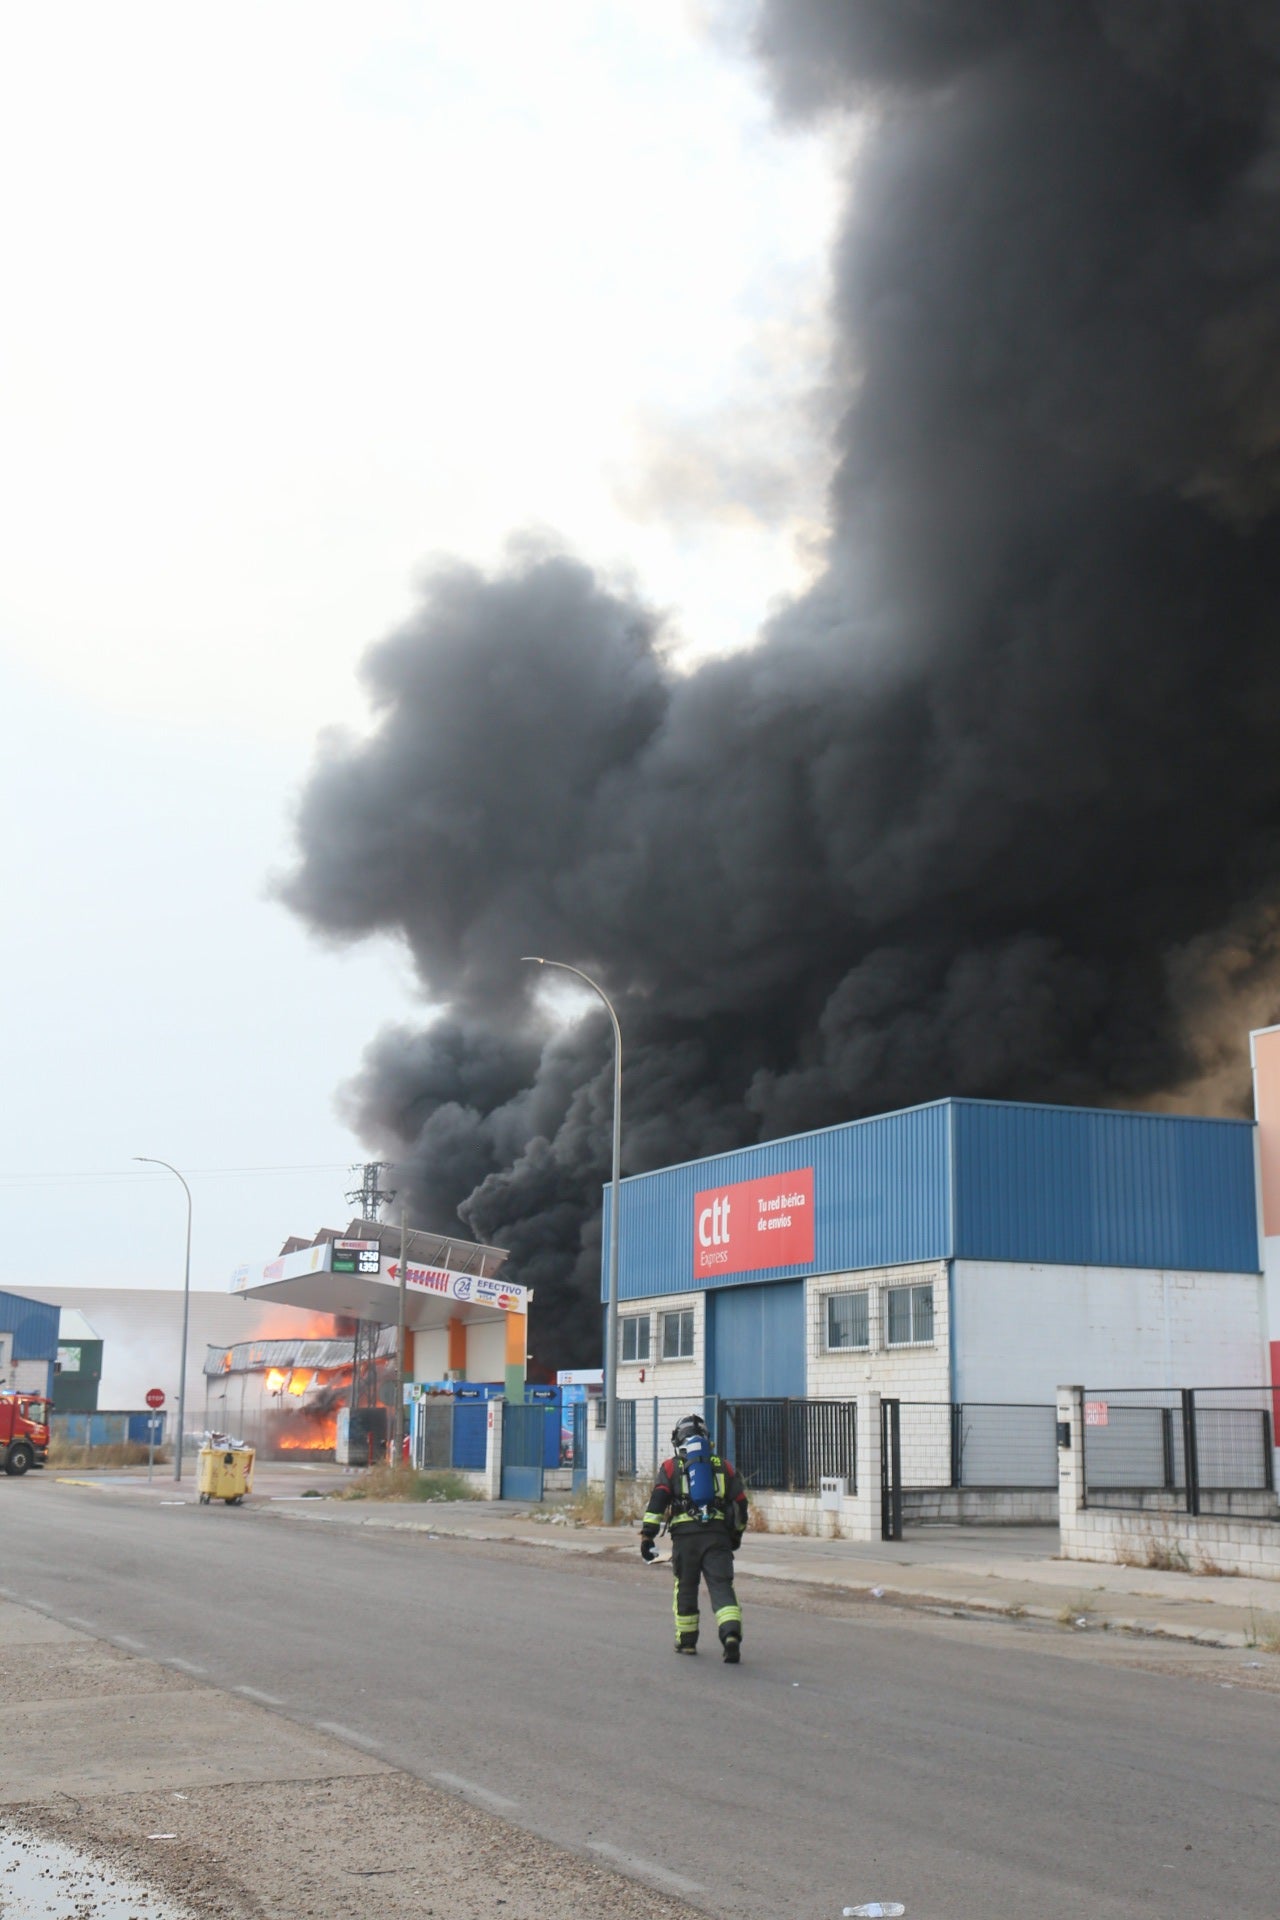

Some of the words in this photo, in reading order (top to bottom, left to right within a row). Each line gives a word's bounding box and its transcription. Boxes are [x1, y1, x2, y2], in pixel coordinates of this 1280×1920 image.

[758, 1199, 767, 1212] Tu
[768, 1195, 780, 1210] red
[699, 1196, 730, 1247] ctt
[758, 1218, 767, 1231] de
[701, 1251, 728, 1267] Express
[458, 1280, 471, 1293] 24
[477, 1280, 521, 1295] EFECTIVO
